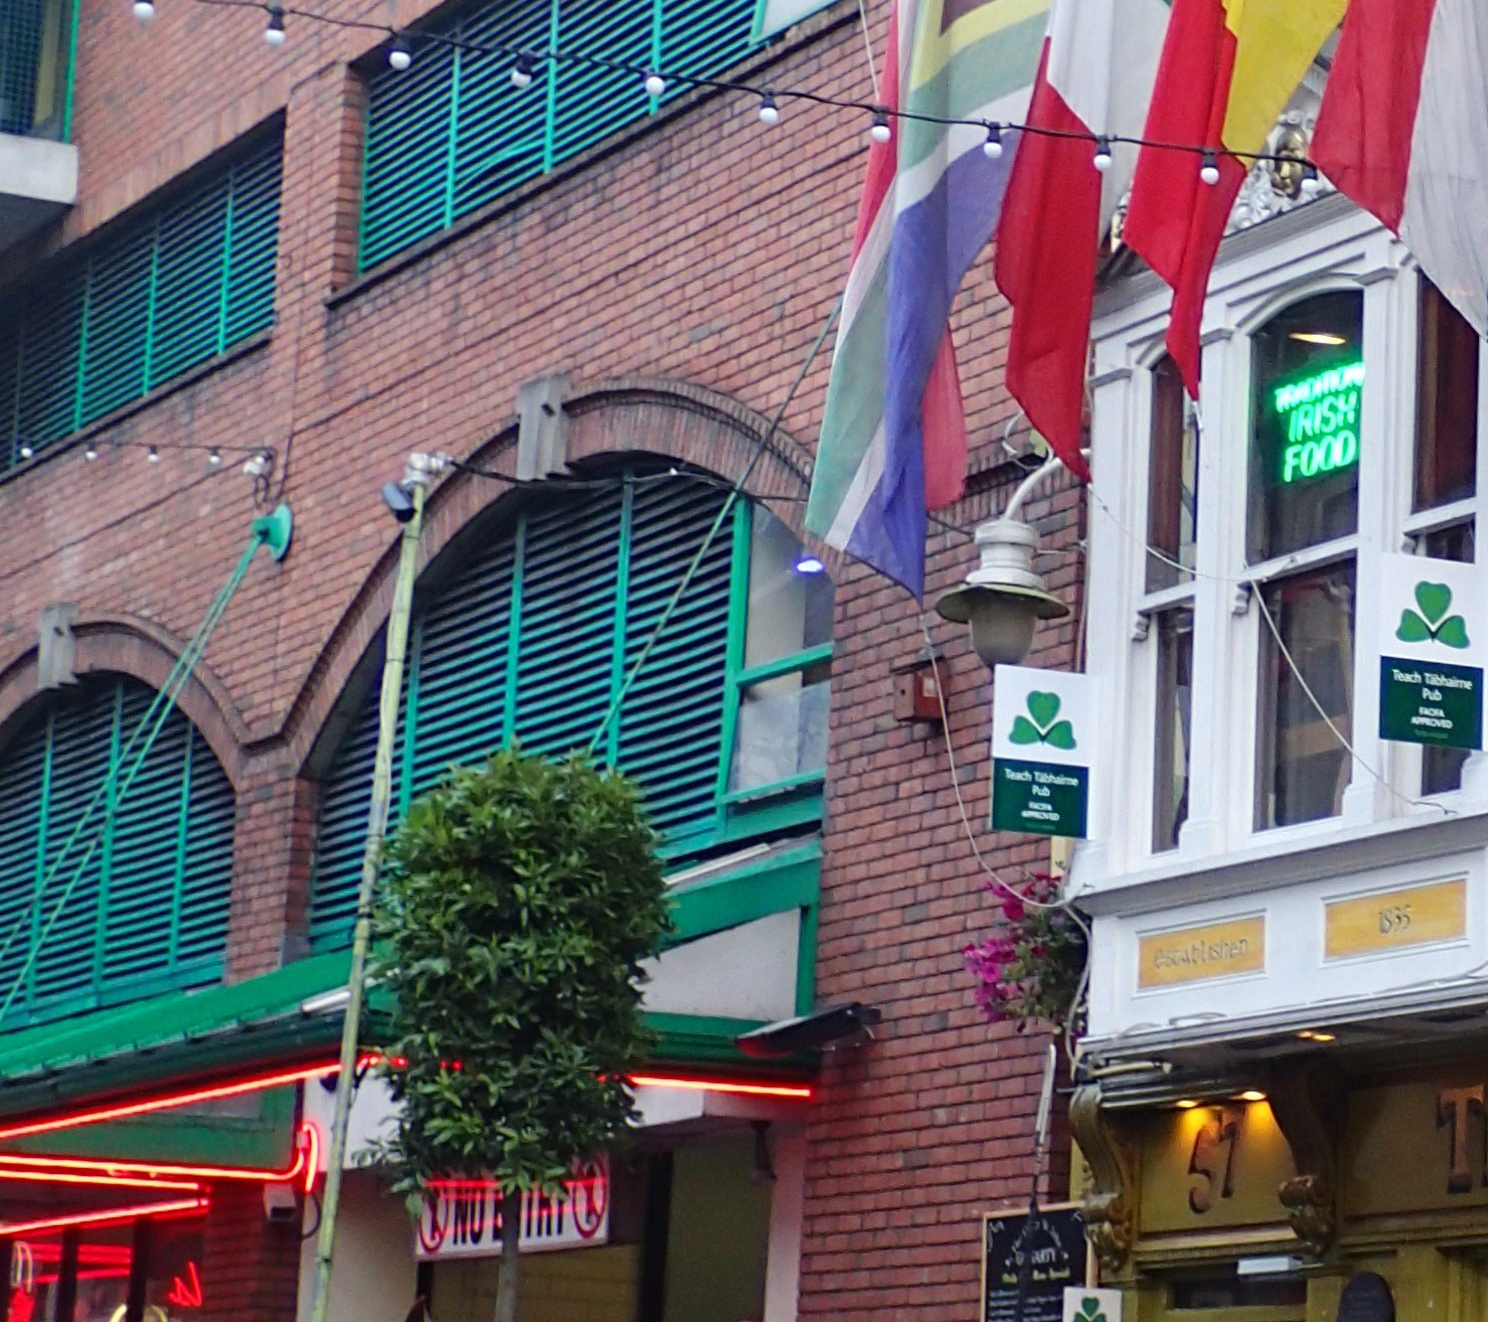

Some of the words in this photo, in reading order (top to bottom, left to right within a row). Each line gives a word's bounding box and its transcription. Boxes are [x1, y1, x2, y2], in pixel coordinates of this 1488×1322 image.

[1288, 390, 1358, 443] IRISH
[1283, 429, 1357, 483] FOOD
[1421, 687, 1443, 702] Pub
